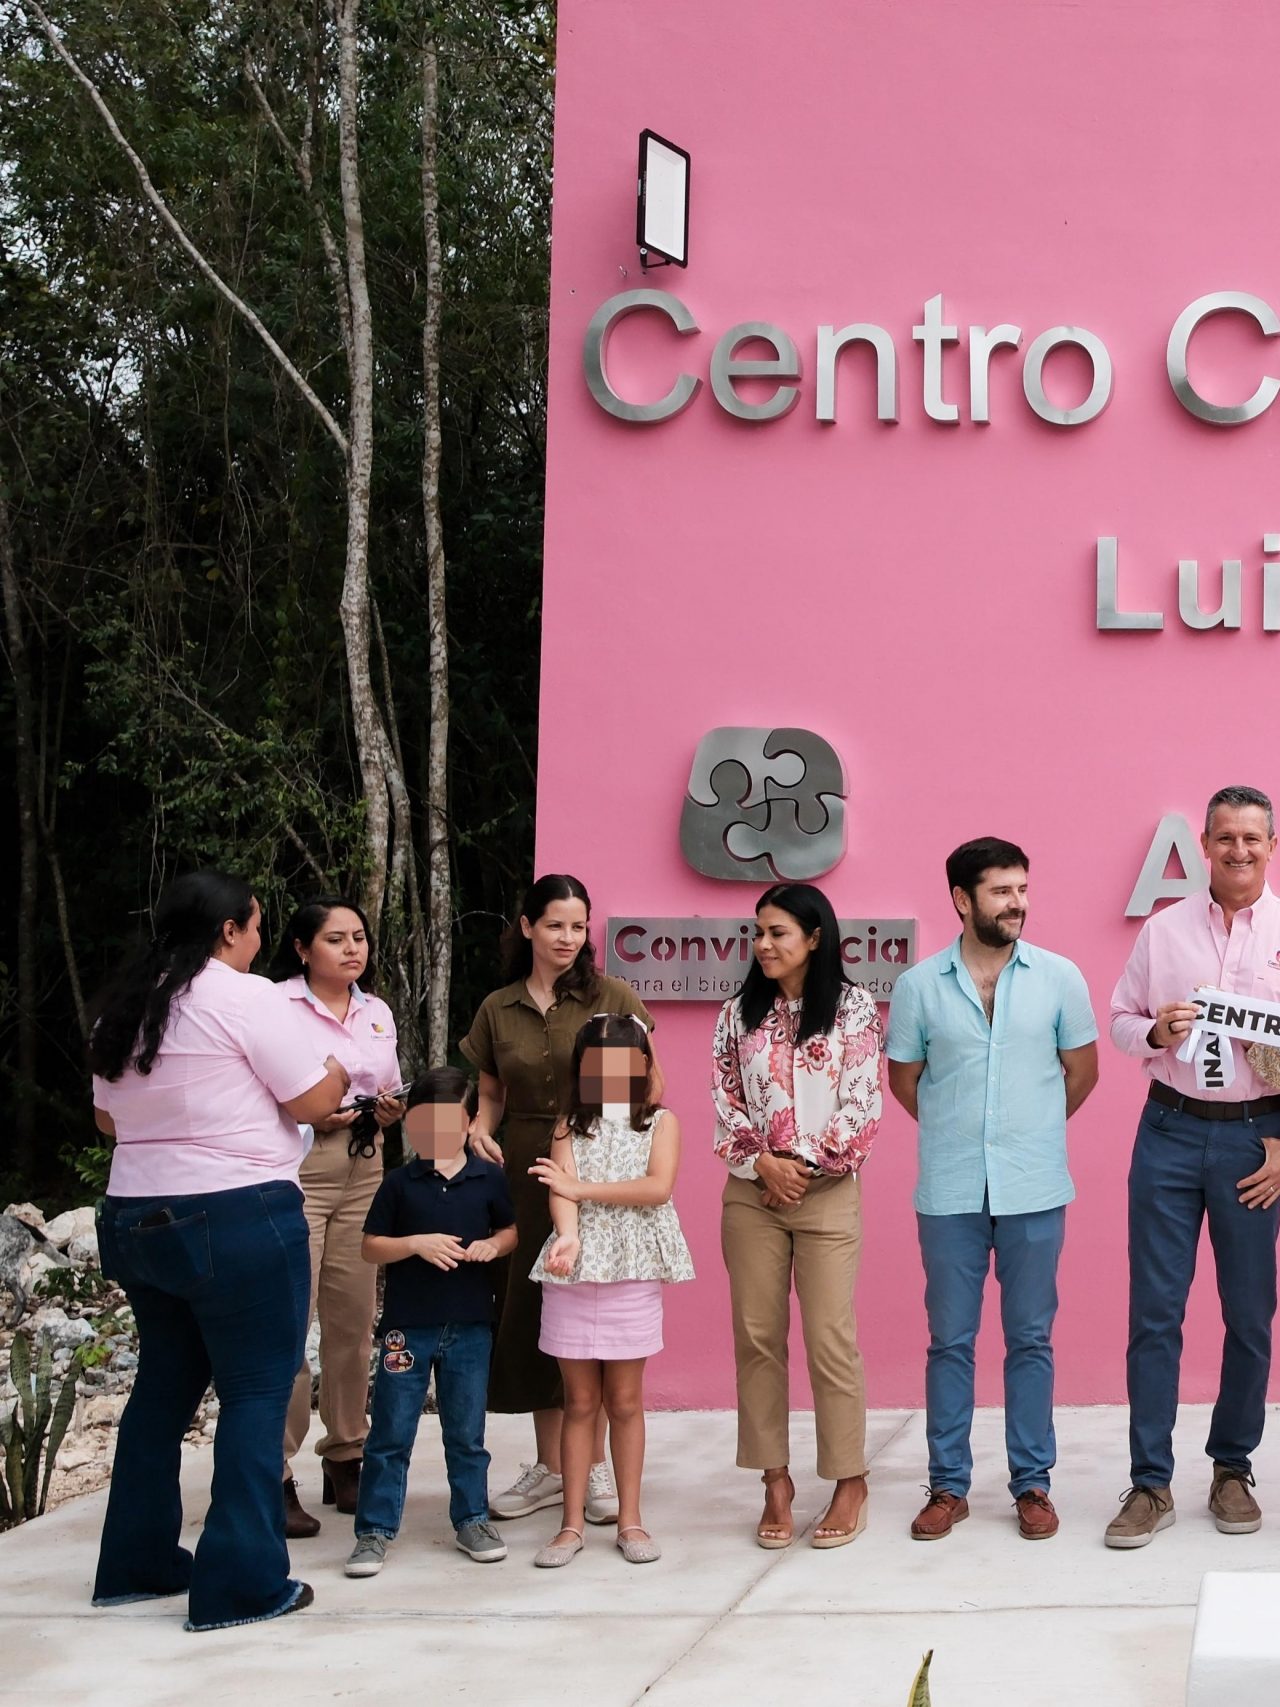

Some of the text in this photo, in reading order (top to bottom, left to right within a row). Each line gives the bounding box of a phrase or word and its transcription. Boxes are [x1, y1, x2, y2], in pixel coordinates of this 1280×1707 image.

[582, 288, 1114, 427] Centro
[614, 925, 908, 964] Convicia
[671, 976, 689, 992] el
